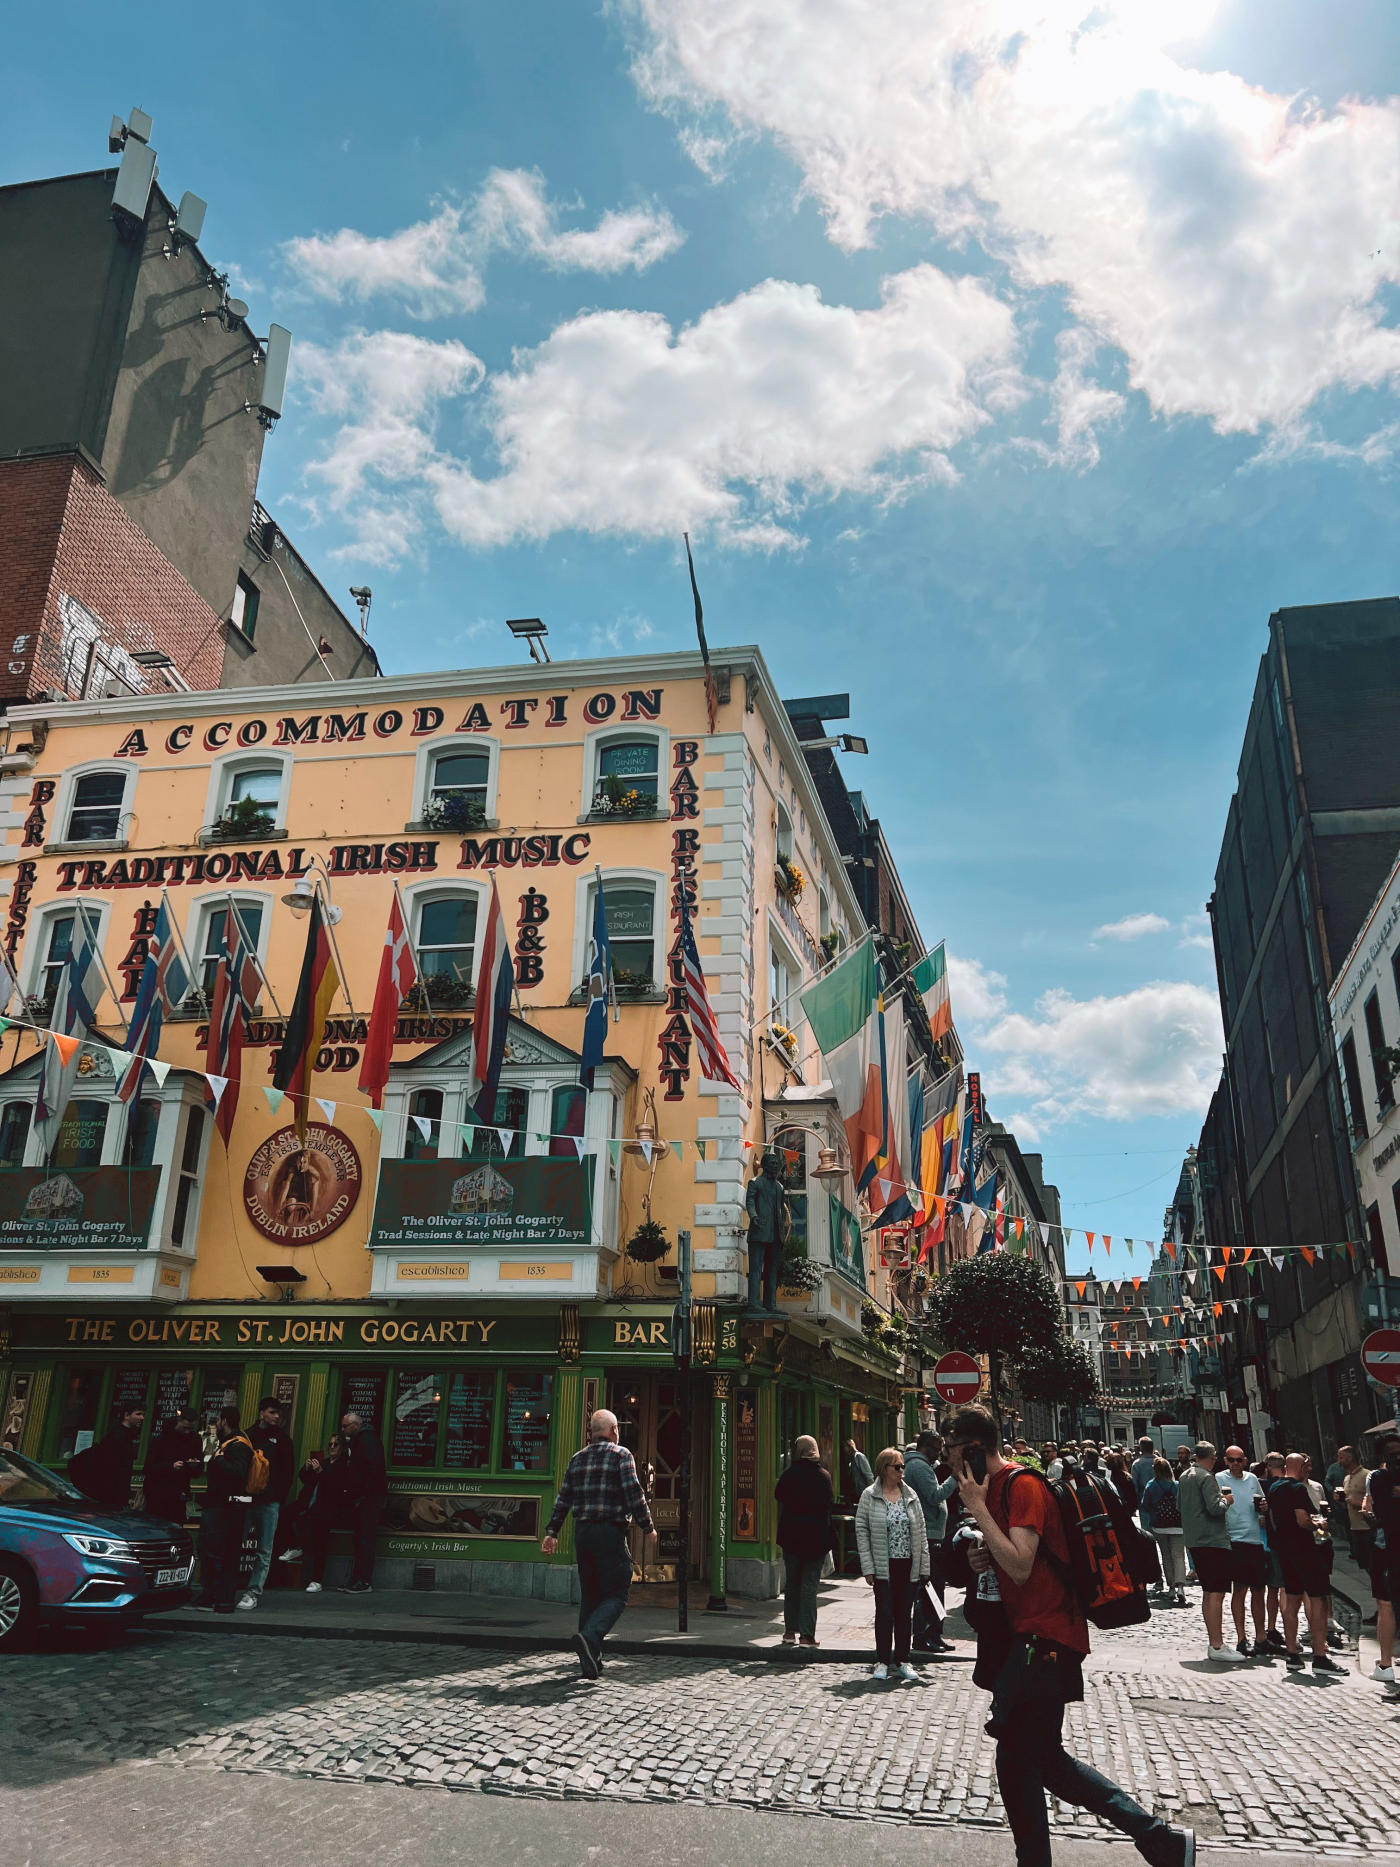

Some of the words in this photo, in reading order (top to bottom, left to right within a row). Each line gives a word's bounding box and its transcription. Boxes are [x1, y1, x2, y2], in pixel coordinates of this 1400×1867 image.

[115, 689, 664, 757] ACCOMMODATION
[671, 741, 700, 821] BAR
[22, 780, 56, 847] BAR
[57, 848, 310, 891] TRADITIONAL
[330, 841, 440, 876] IRISH
[457, 833, 592, 870] MUSIC
[514, 893, 549, 988] B&B
[63, 1138, 96, 1149] FOOD
[246, 1140, 280, 1181] OLIVER
[277, 1130, 293, 1145] ST
[326, 1134, 359, 1181] GOGARTY
[261, 1157, 277, 1178] EST
[275, 1141, 300, 1159] 1835
[1, 1221, 34, 1232] Oliver
[53, 1221, 79, 1234] John
[81, 1220, 126, 1234] Gogarty
[246, 1194, 289, 1238] DUBLIN
[291, 1194, 350, 1238] IRELAND
[401, 1215, 424, 1226] The
[426, 1215, 462, 1226] Oliver
[464, 1215, 481, 1226] St.
[483, 1214, 512, 1228] John
[514, 1214, 564, 1227] Gogarty
[26, 1234, 34, 1245] &
[36, 1234, 58, 1245] Late
[60, 1232, 89, 1247] Night
[90, 1232, 108, 1244] Bar
[110, 1232, 117, 1244] 7
[118, 1232, 144, 1246] Days
[377, 1229, 403, 1240] Trad
[404, 1230, 453, 1240] Sessions
[454, 1230, 465, 1240] &
[466, 1229, 490, 1240] Late
[492, 1229, 526, 1241] Night
[527, 1229, 546, 1239] Bar
[548, 1229, 555, 1239] 7
[557, 1228, 585, 1240] Days
[526, 1265, 547, 1276] 1835
[65, 1318, 116, 1342] THE
[129, 1318, 222, 1342] OLIVER
[237, 1319, 274, 1343] ST.
[278, 1320, 345, 1343] JOHN
[360, 1320, 497, 1343] GOGARTY
[614, 1321, 669, 1345] BAR
[722, 1319, 738, 1334] 57
[721, 1336, 738, 1350] 58
[719, 1402, 728, 1472] PENTHOUSE
[387, 1481, 432, 1491] Traditional
[434, 1482, 455, 1492] Irish
[456, 1482, 482, 1492] Music
[719, 1474, 727, 1551] APARTMENTS
[388, 1540, 428, 1553] Gogarty's
[431, 1541, 452, 1552] Irish
[453, 1543, 469, 1552] Bar
